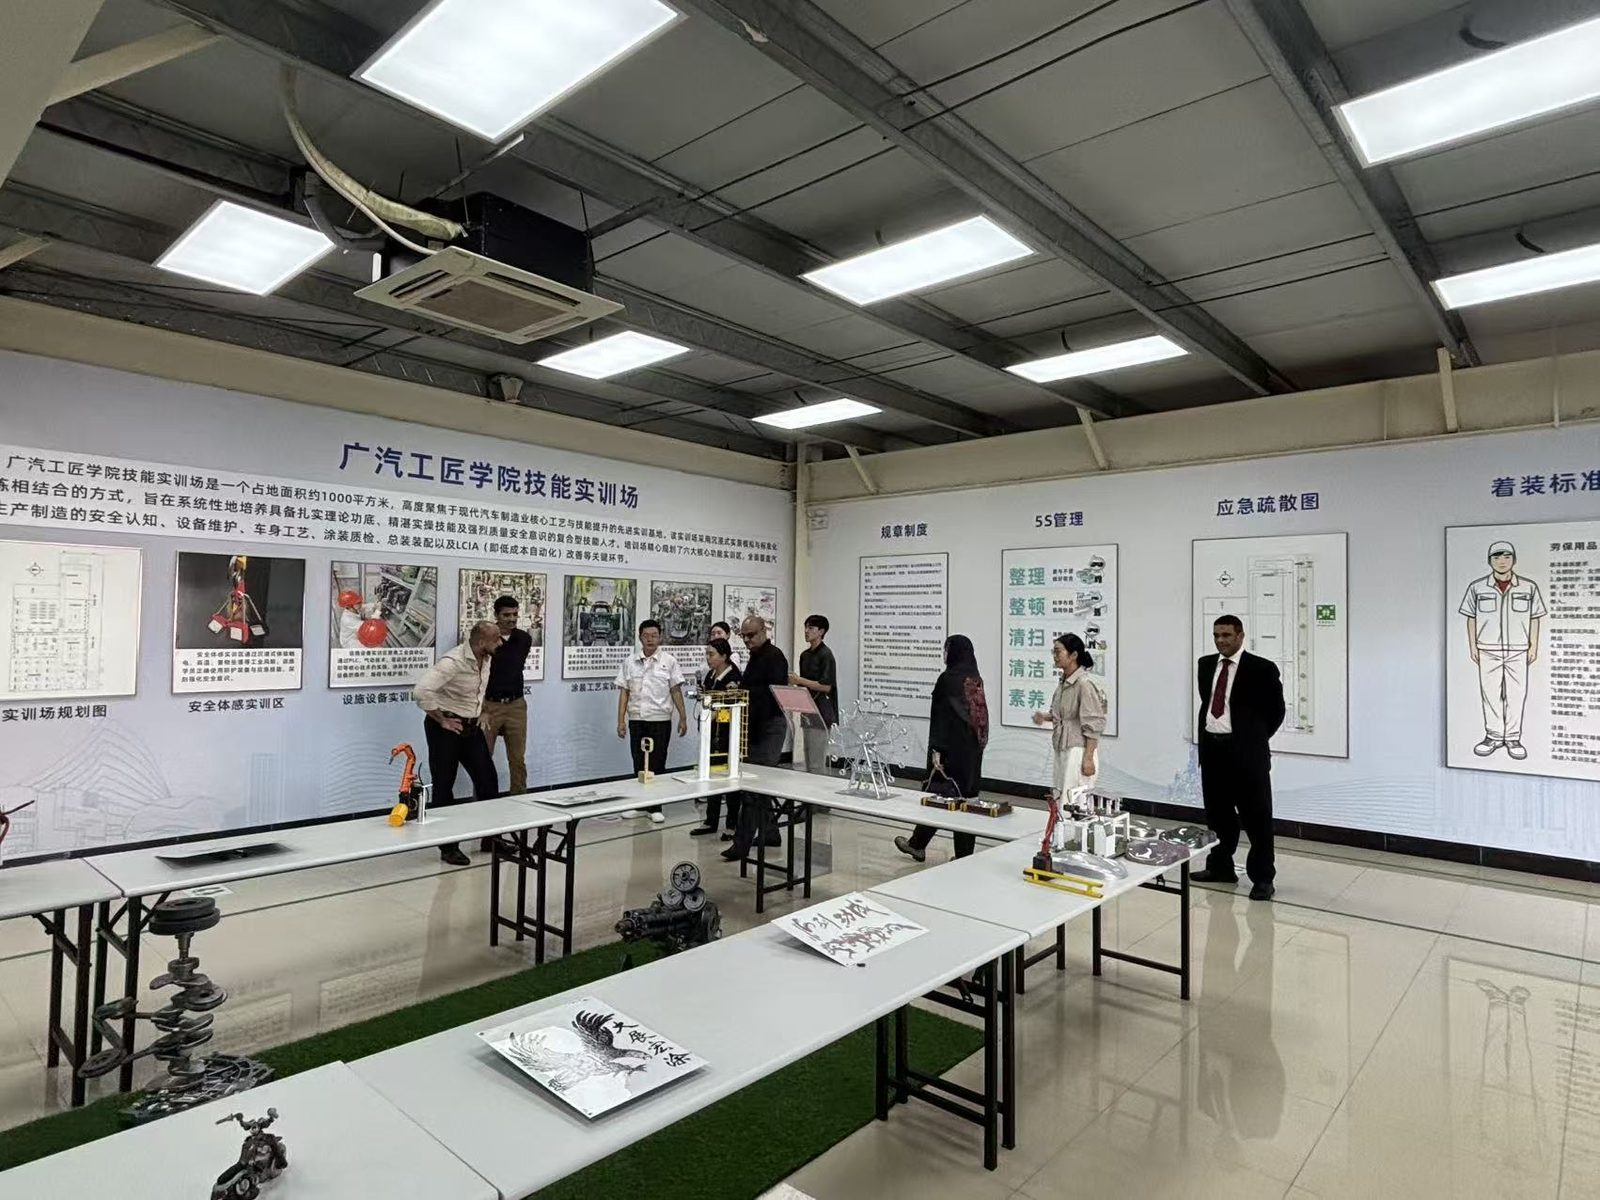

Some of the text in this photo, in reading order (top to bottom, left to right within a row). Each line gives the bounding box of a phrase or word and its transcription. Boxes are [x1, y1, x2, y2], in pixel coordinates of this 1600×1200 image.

[340, 443, 640, 509] 广汽工匠学院技能实训场
[1491, 470, 1600, 498] 着装标准
[1216, 492, 1320, 517] 应急疏散图
[1035, 511, 1084, 528] 5S管理
[880, 523, 929, 539] 规章制度
[1009, 567, 1045, 587] 整理
[1009, 597, 1046, 617] 整顿
[1008, 627, 1045, 647] 清扫
[1008, 659, 1045, 679] 清洁
[571, 681, 621, 693] 涂装工艺实训
[188, 697, 285, 713] 安全体感实训区
[1008, 688, 1046, 709] 素养
[1, 704, 108, 722] 实训场规划图
